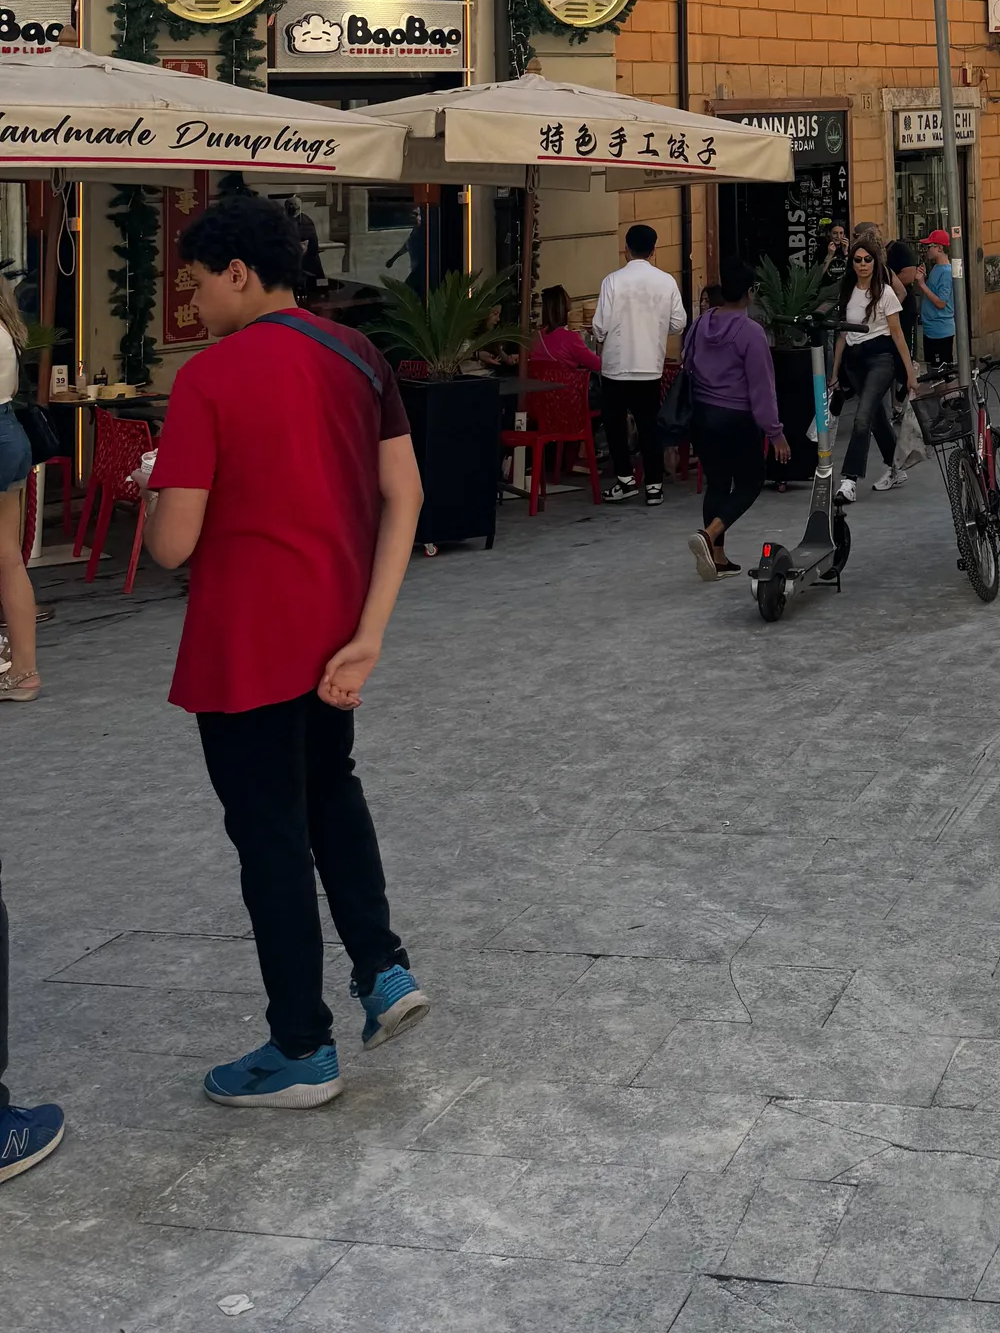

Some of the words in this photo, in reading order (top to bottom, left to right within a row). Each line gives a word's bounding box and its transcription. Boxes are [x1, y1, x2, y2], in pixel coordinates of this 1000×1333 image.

[347, 14, 462, 48] BaoBao
[349, 47, 395, 55] CHINESE
[400, 47, 452, 55] DUMPLING
[918, 112, 971, 130] TABCHI
[0, 113, 156, 148] andmade
[168, 120, 341, 164] Dumplings
[538, 121, 718, 166] 特色手工饺子
[838, 165, 848, 201] ATM
[2, 1127, 30, 1159] N
